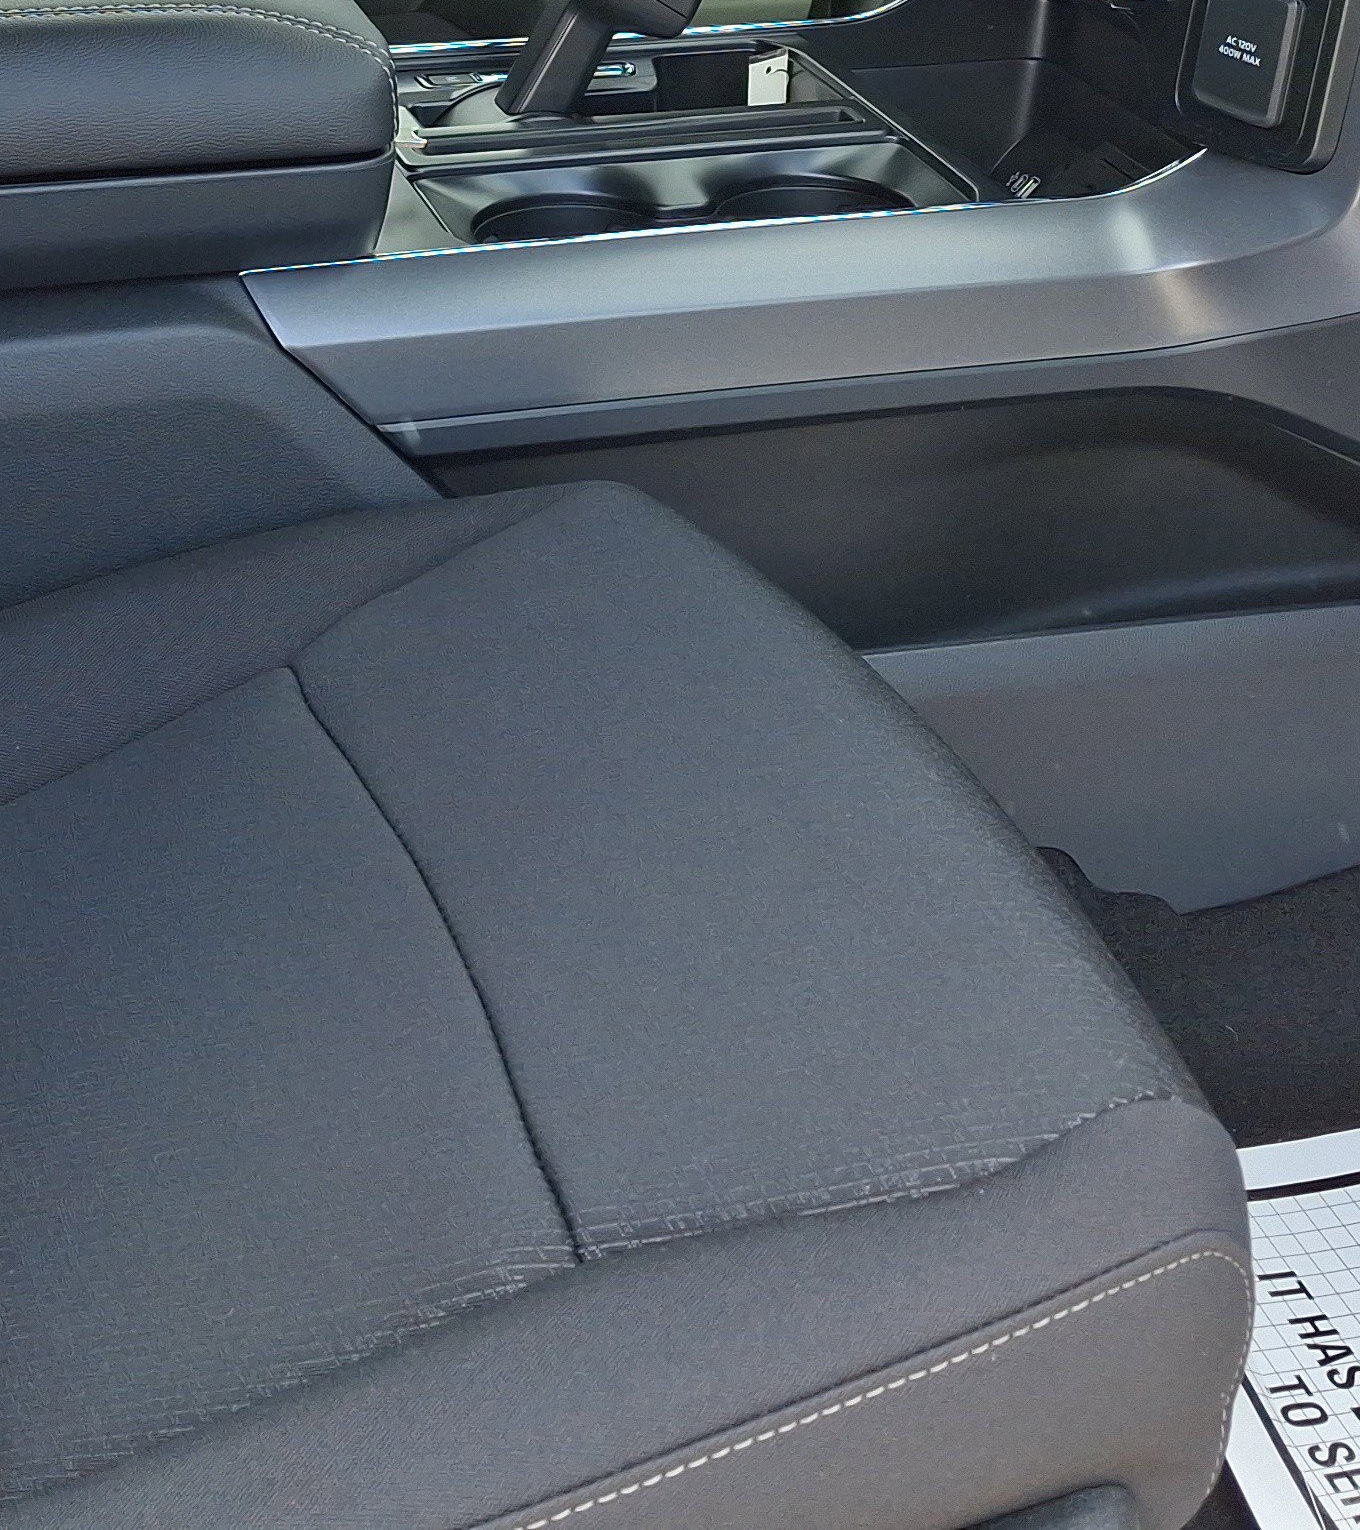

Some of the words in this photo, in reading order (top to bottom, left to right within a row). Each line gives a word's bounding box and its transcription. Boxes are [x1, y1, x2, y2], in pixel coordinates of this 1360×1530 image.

[1219, 44, 1241, 60] 400W
[1242, 50, 1261, 67] MAX
[1225, 35, 1237, 46] AC
[1238, 39, 1257, 53] 120V
[1257, 1271, 1314, 1300] IT
[1269, 1374, 1329, 1427] TO
